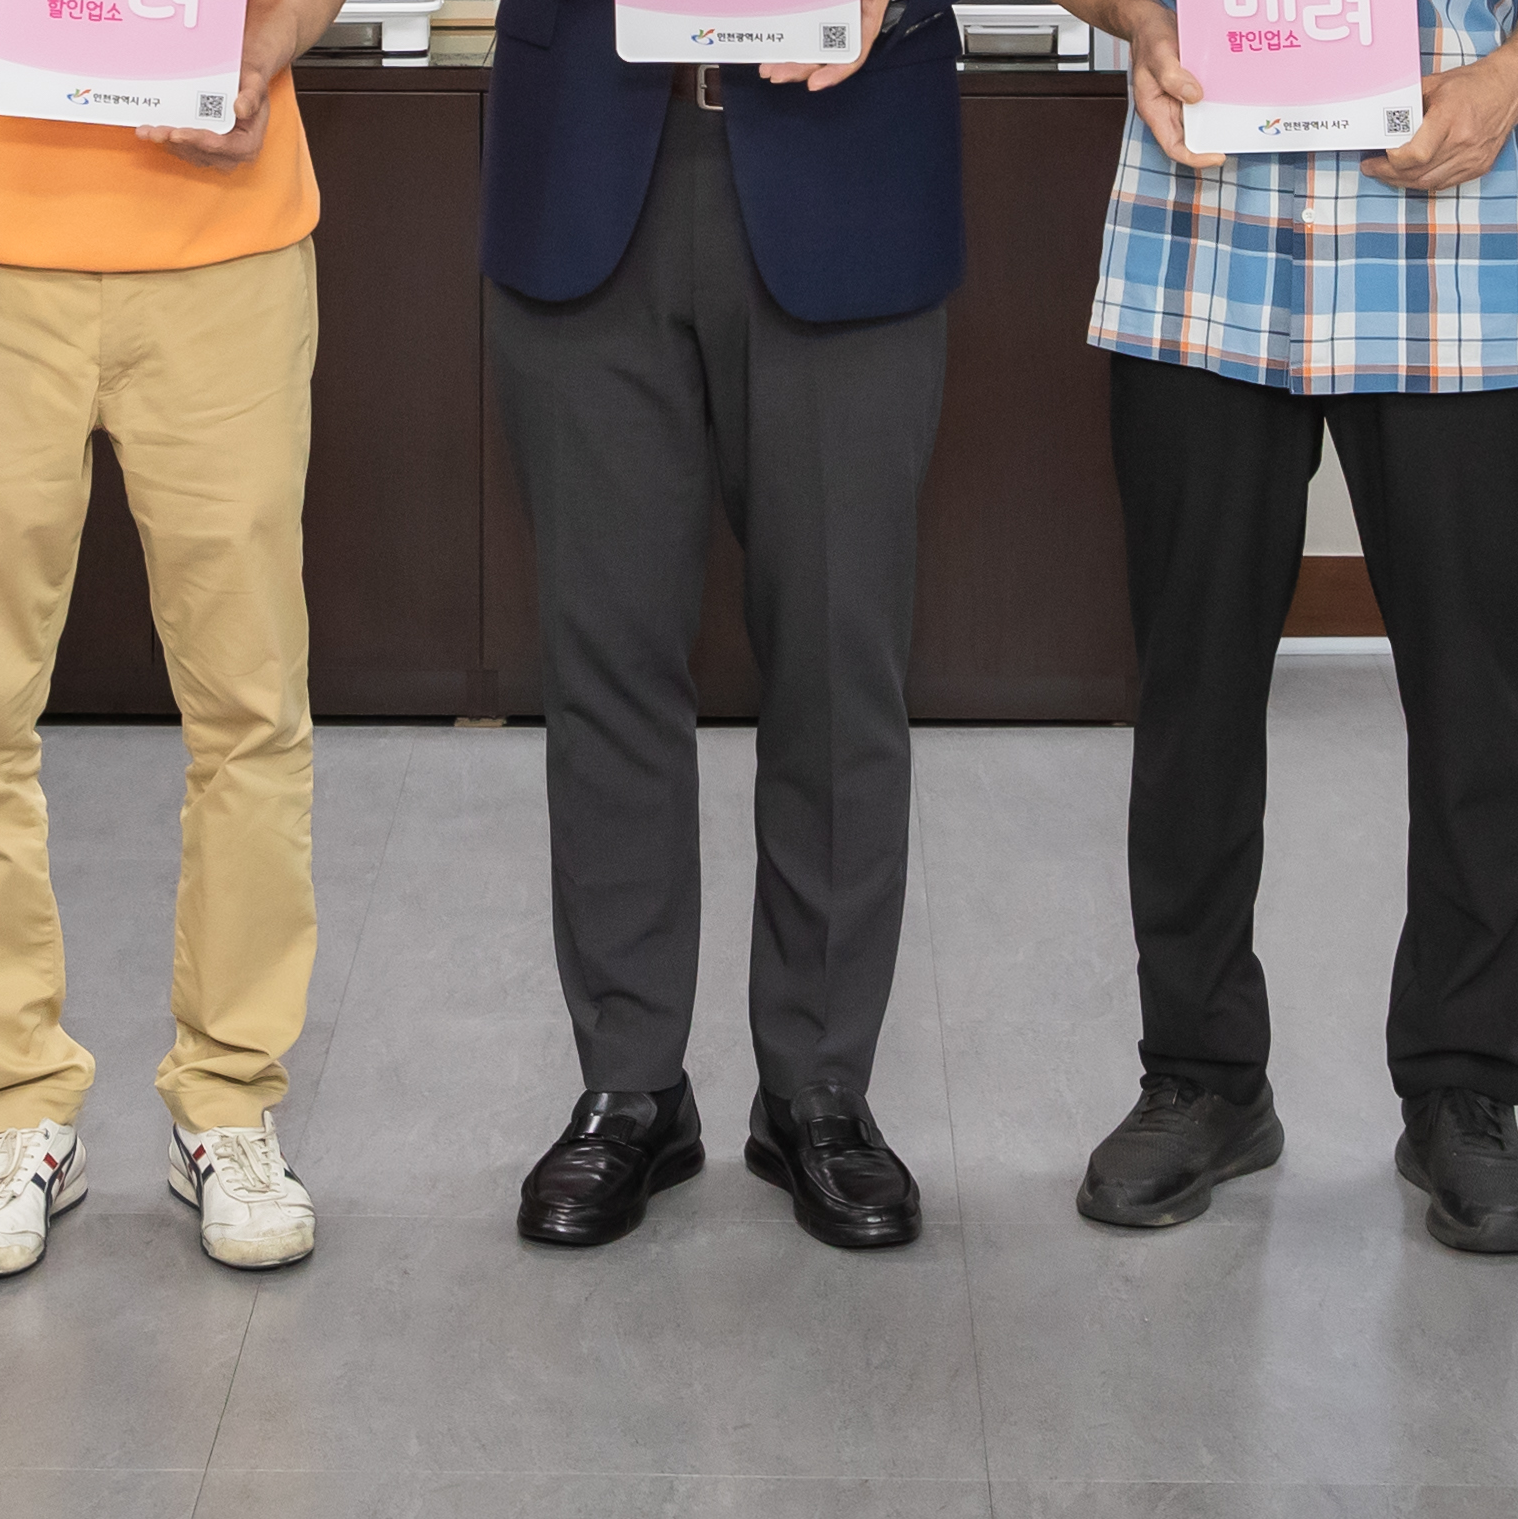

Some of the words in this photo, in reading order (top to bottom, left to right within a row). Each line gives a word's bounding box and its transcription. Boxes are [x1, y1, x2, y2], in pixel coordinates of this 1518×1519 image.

[716, 31, 764, 44] 인천광역시
[766, 32, 785, 44] 서구
[1226, 29, 1303, 53] 할인업소
[93, 92, 140, 107] 인천광역시
[142, 95, 162, 108] 서구
[1282, 119, 1329, 132] 인천광역시
[1331, 118, 1350, 130] 서구
